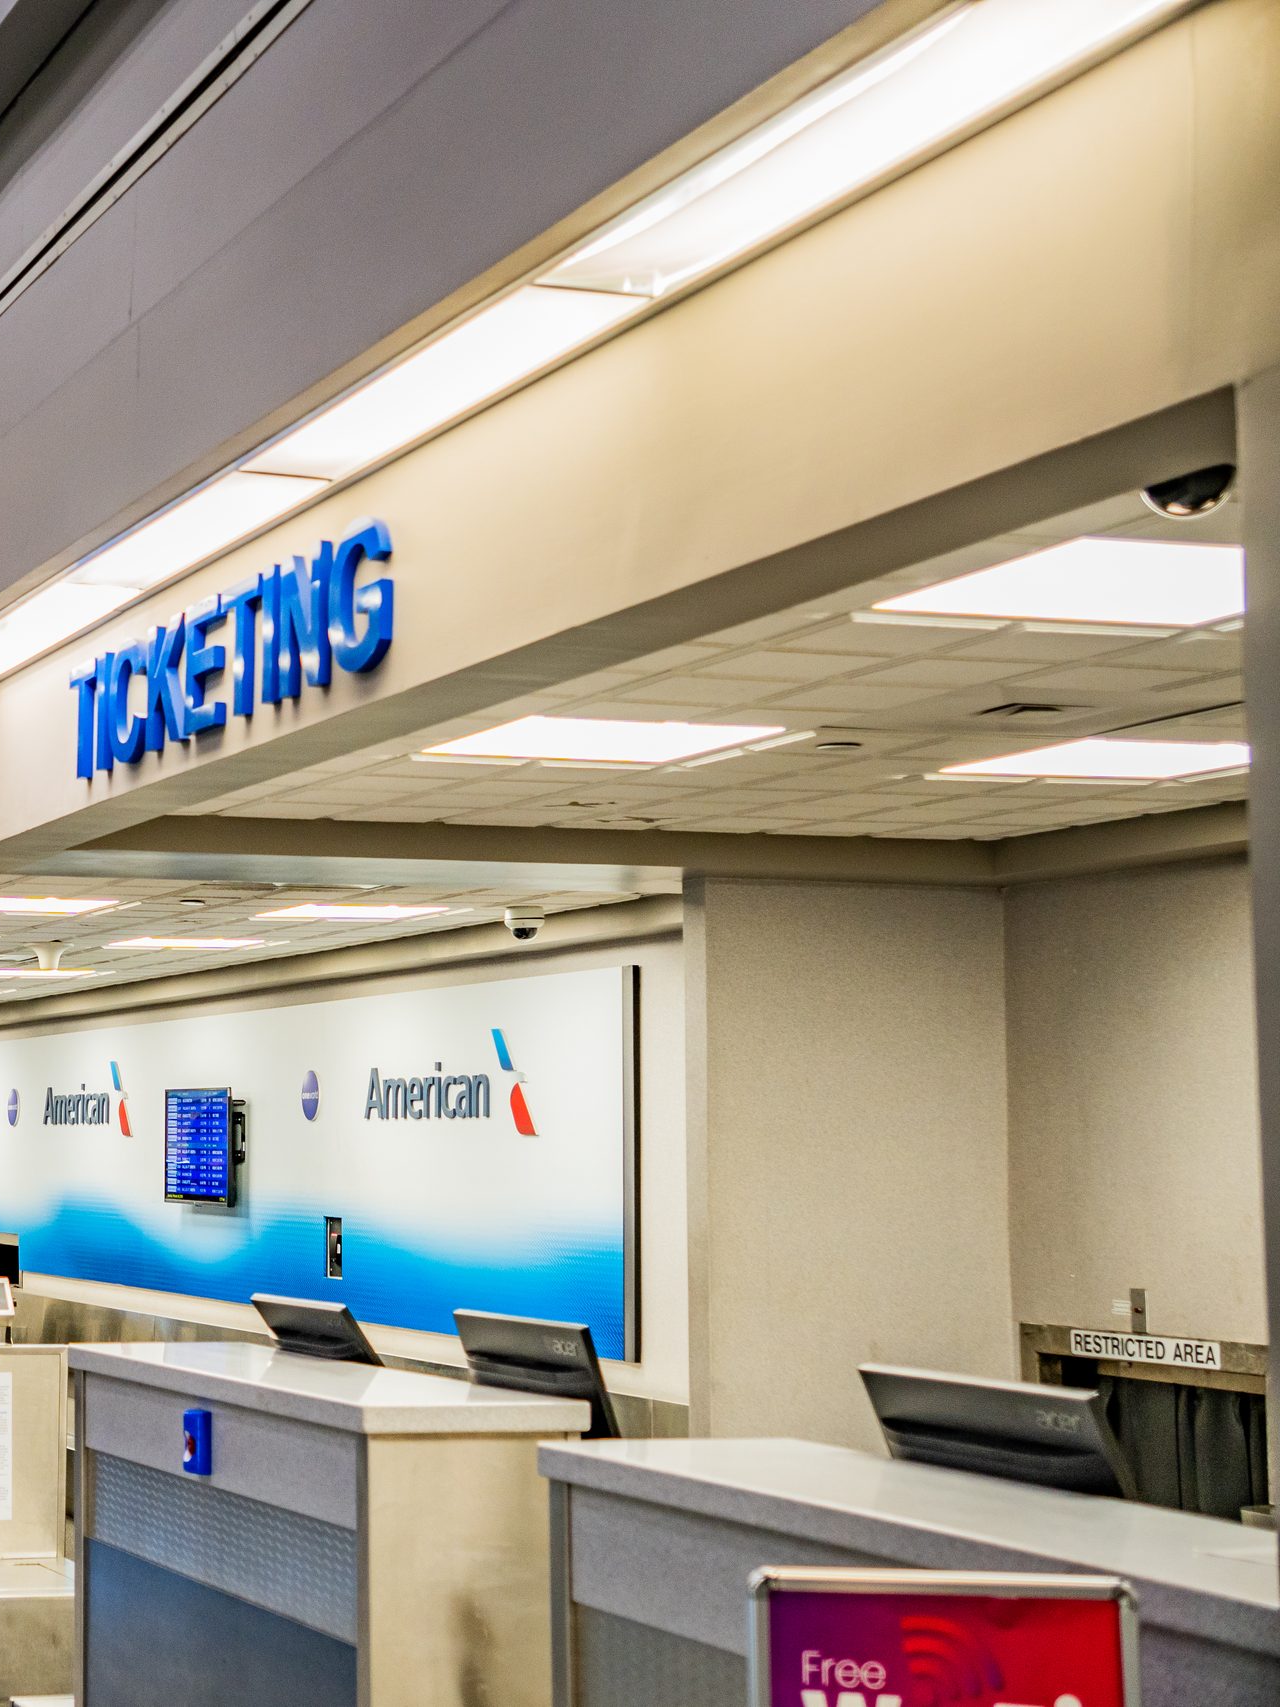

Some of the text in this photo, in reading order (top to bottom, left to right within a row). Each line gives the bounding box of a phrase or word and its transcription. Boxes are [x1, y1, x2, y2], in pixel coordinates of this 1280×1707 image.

[70, 516, 394, 780] TICKETING
[43, 1083, 110, 1126] American
[364, 1061, 490, 1120] American
[552, 1339, 578, 1357] acer
[1073, 1333, 1217, 1366] RESTRICTED AREA
[801, 1650, 887, 1690] Free
